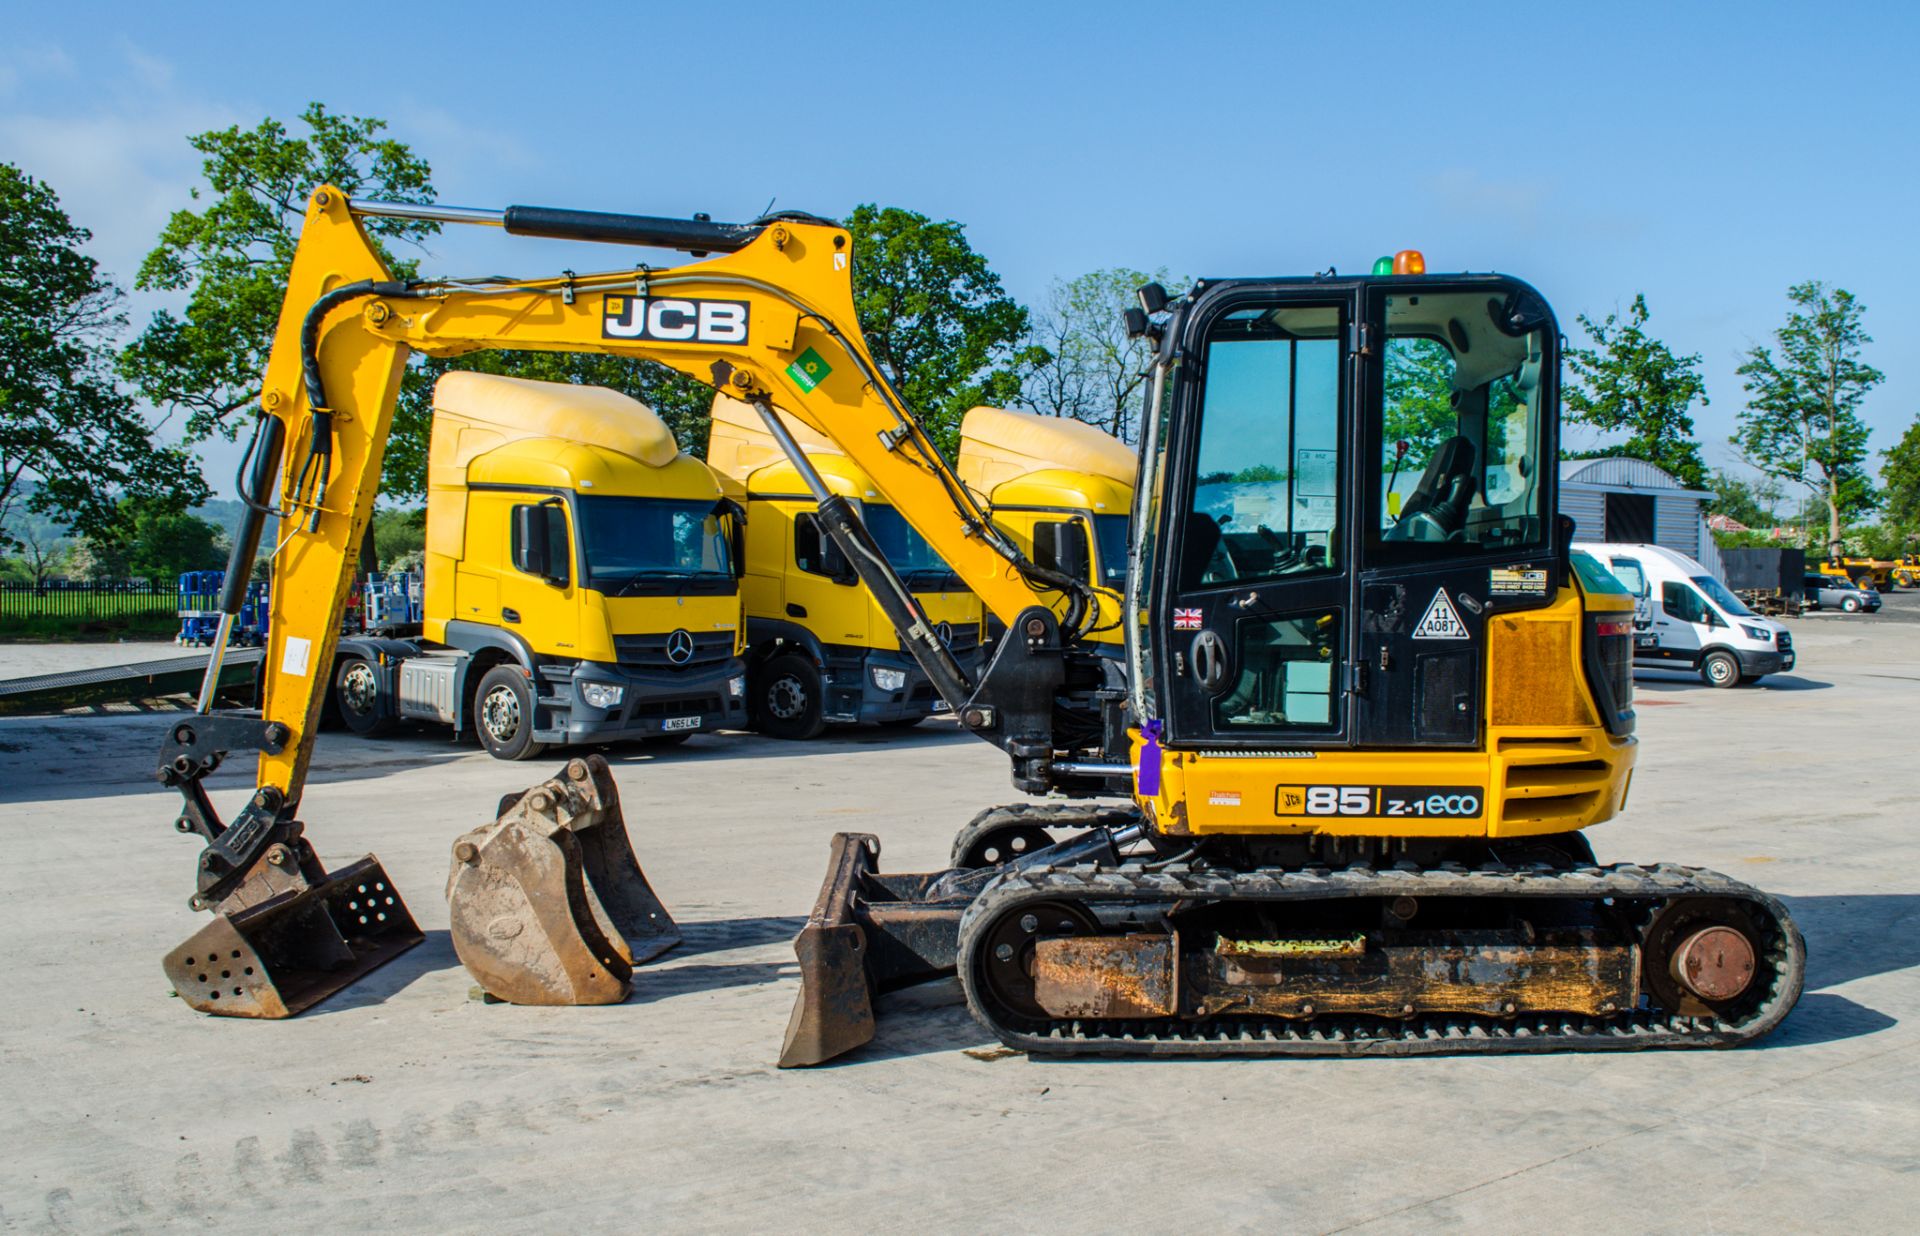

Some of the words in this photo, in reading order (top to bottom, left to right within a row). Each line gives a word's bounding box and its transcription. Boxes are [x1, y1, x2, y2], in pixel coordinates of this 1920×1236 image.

[605, 298, 747, 342] JCB
[1434, 608, 1448, 619] 11
[666, 718, 686, 730] LN65
[686, 716, 699, 728] LNE
[1306, 787, 1371, 815] 85
